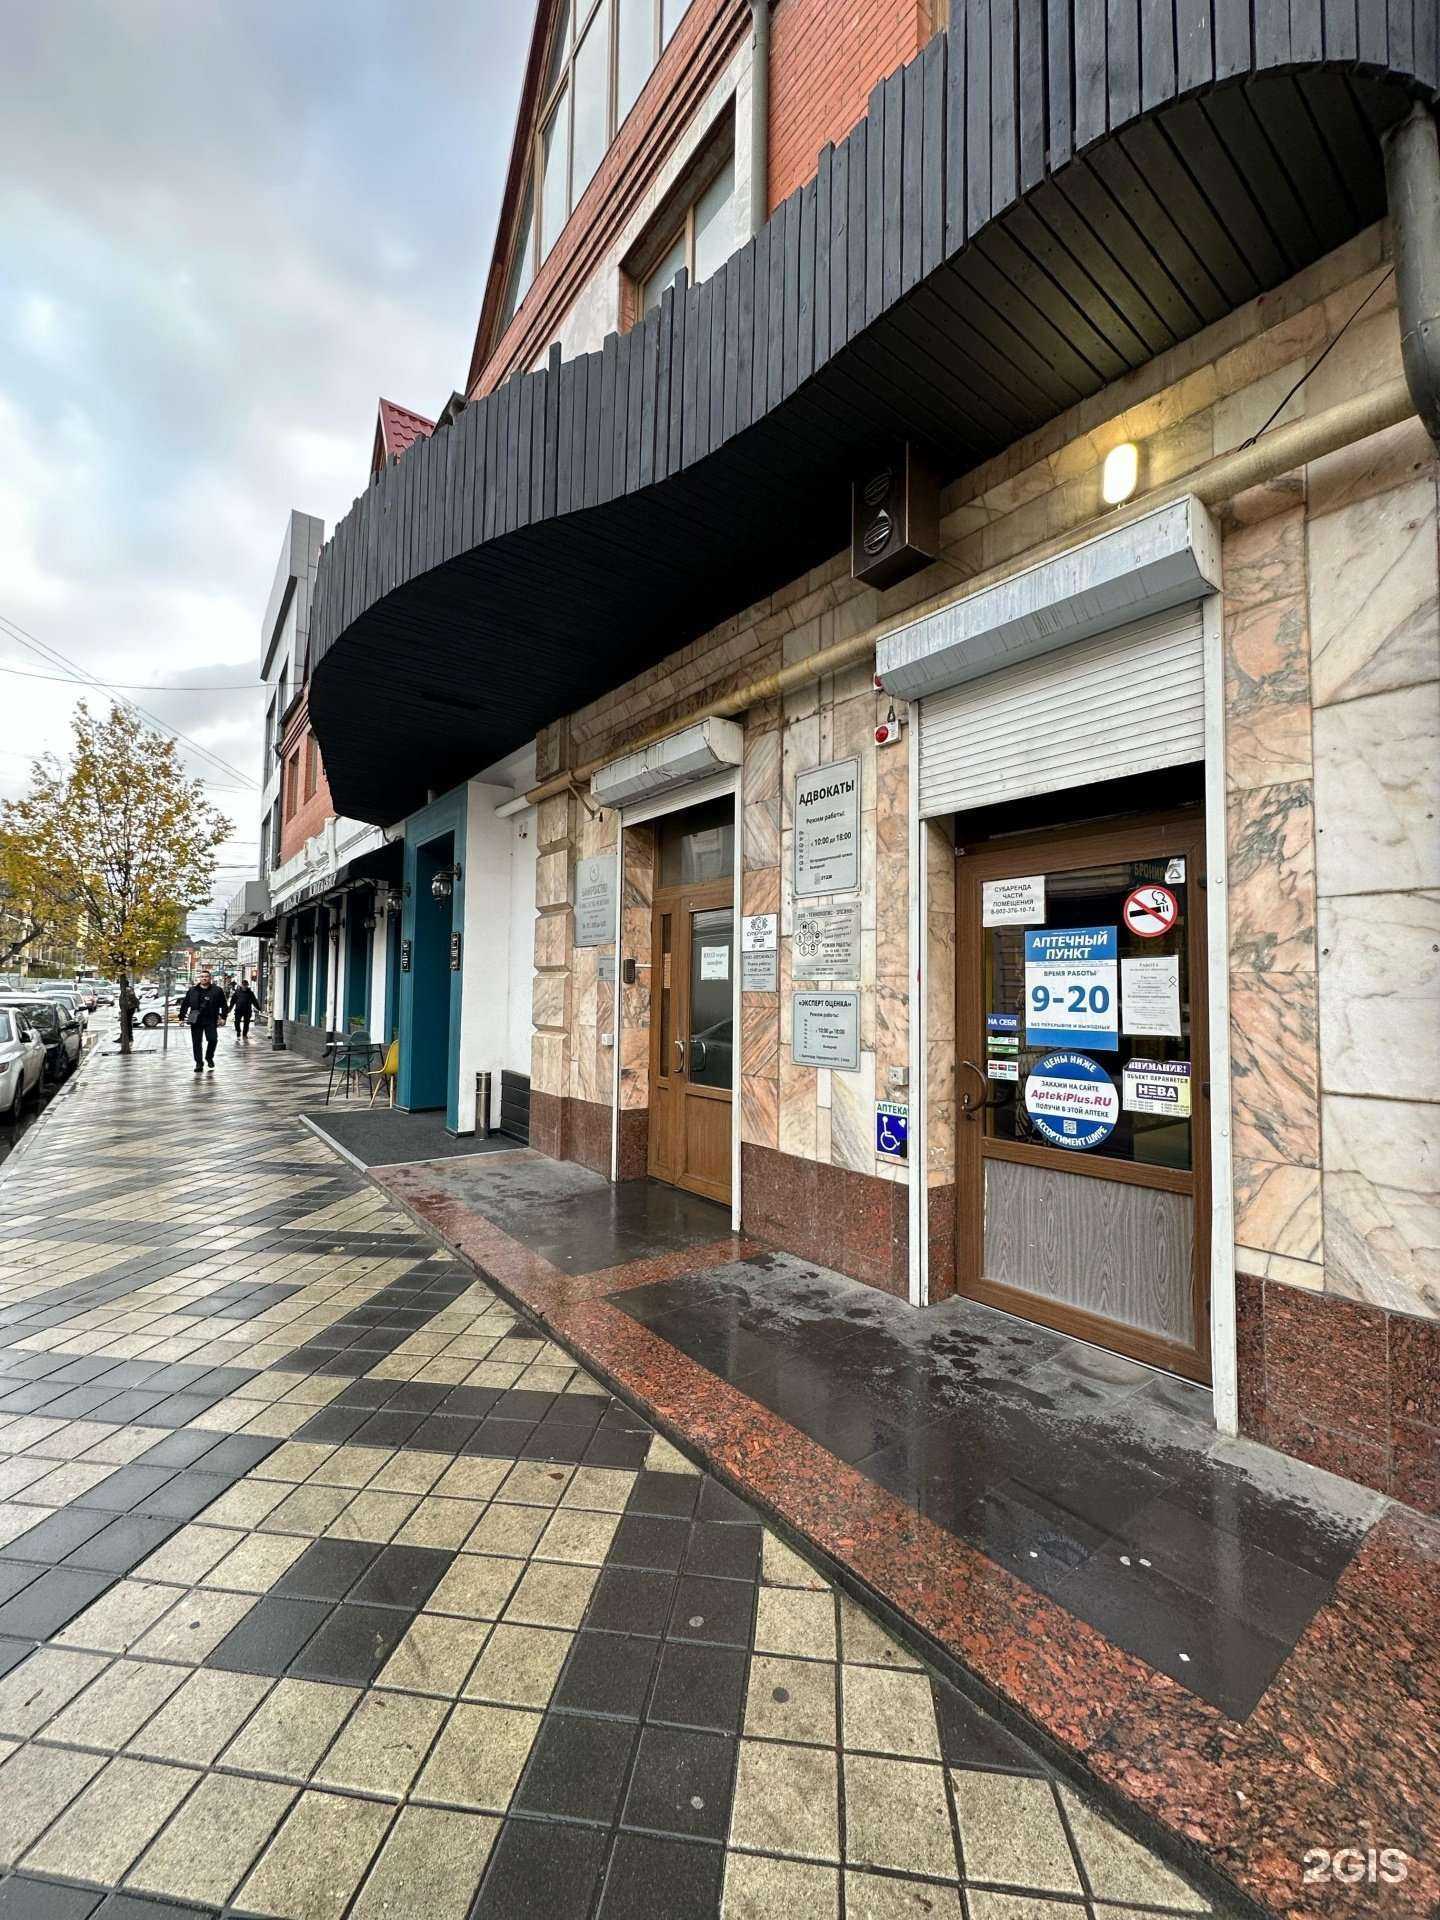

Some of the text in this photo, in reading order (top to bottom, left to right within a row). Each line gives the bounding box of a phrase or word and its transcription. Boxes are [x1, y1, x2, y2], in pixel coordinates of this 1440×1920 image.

[799, 780, 854, 806] АДВОКАТЫ
[993, 899, 1034, 907] ПОМЕЩЕНИЯ
[1032, 931, 1109, 948] АПТЕЧНЫЙ
[1045, 947, 1092, 960] ПУНКТ
[1032, 985, 1110, 1013] 9-20
[988, 1017, 1017, 1026] НА СЕБЯ
[1043, 1055, 1097, 1073] ЦЕНЫ НИЖЕ
[1129, 1061, 1187, 1073] ВНИМАНИЕ!
[1041, 1080, 1068, 1089] ЗАКАЖИ
[1079, 1084, 1099, 1092] САЙТЕ
[1138, 1084, 1177, 1098] НЕВА
[1031, 1089, 1112, 1106] AptekiPlus.RU
[877, 1103, 907, 1116] АПТЕКА
[1035, 1102, 1060, 1112] ПОЛУЧИ
[1067, 1106, 1084, 1114] ЭТОЙ
[1084, 1110, 1110, 1118] АПТЕКЕ
[1035, 1118, 1108, 1146] АССОРТИМЕНТ ШИРЕ
